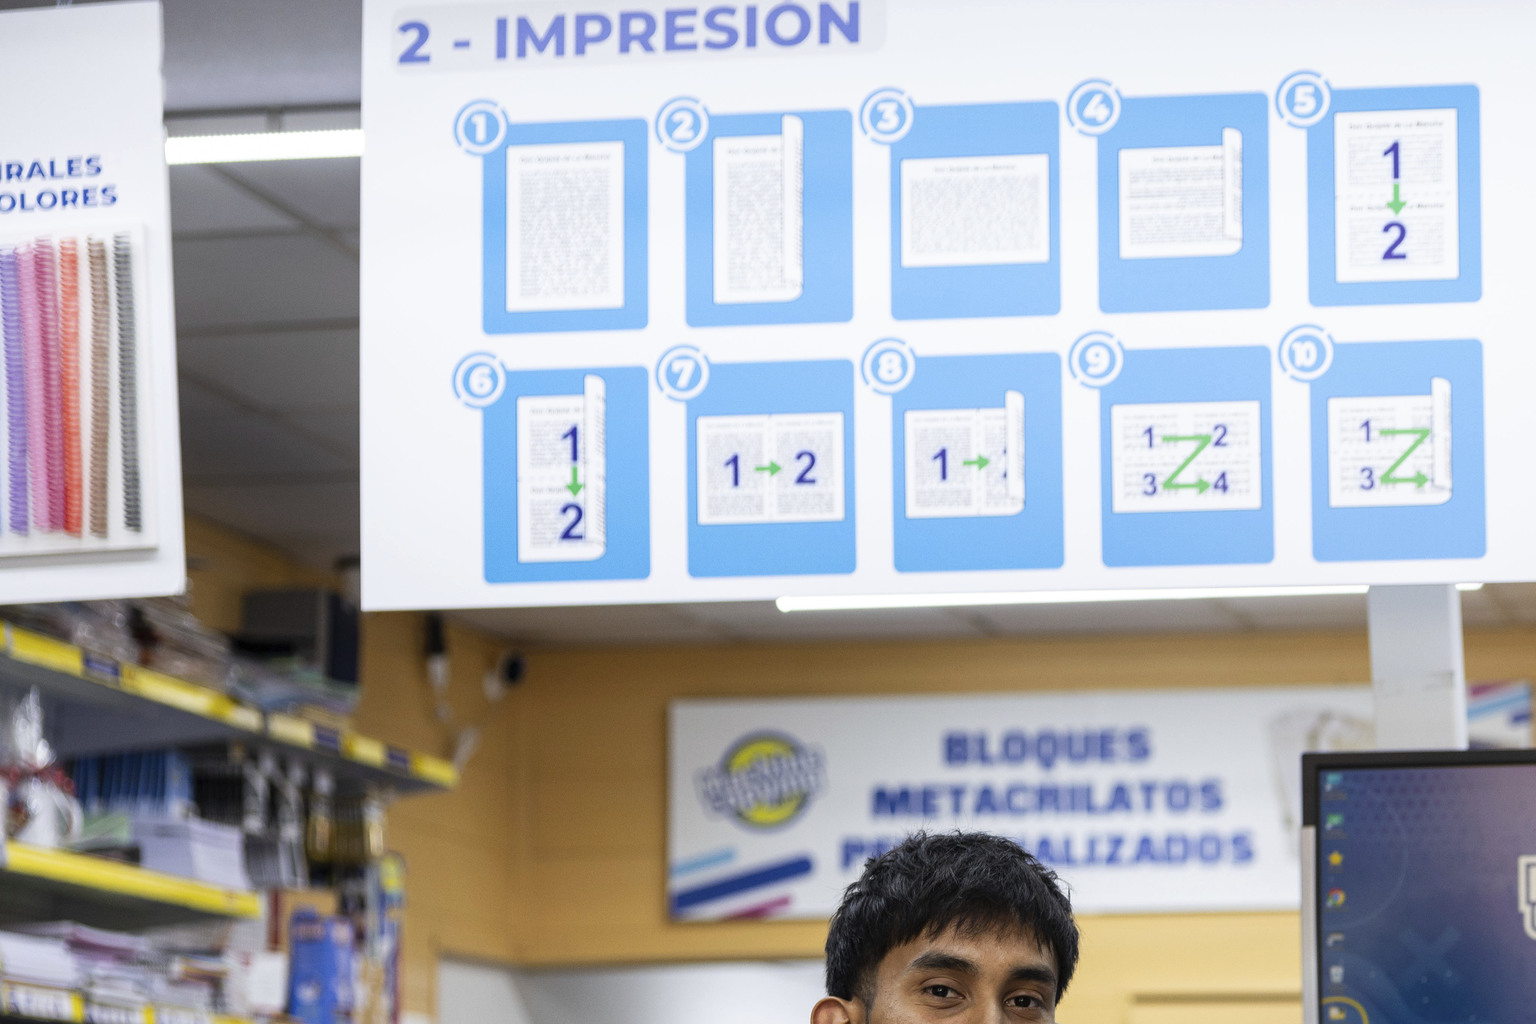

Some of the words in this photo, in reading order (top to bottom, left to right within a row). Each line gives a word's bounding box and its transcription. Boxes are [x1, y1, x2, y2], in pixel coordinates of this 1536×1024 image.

[398, 21, 431, 64] 2
[1084, 95, 1108, 121] 4
[1292, 86, 1316, 113] 5
[473, 114, 487, 141] 1
[672, 112, 694, 139] 2
[877, 103, 899, 130] 3
[1384, 141, 1399, 179] 1
[1381, 221, 1408, 261] 2
[879, 353, 900, 380] 8
[1086, 347, 1108, 373] 9
[1292, 340, 1318, 368] 10
[470, 367, 491, 394] 6
[674, 360, 695, 388] 7
[560, 426, 581, 463] 1
[1142, 427, 1157, 449] 1
[1212, 424, 1229, 447] 2
[1358, 420, 1373, 443] 1
[723, 454, 742, 488] 1
[794, 451, 816, 485] 2
[931, 448, 950, 482] 1
[1142, 473, 1158, 497] 3
[1212, 472, 1230, 495] 4
[1359, 467, 1375, 492] 3
[559, 504, 585, 542] 2
[943, 727, 1151, 770] BLOQUES
[870, 779, 1225, 819] METACRILATOS
